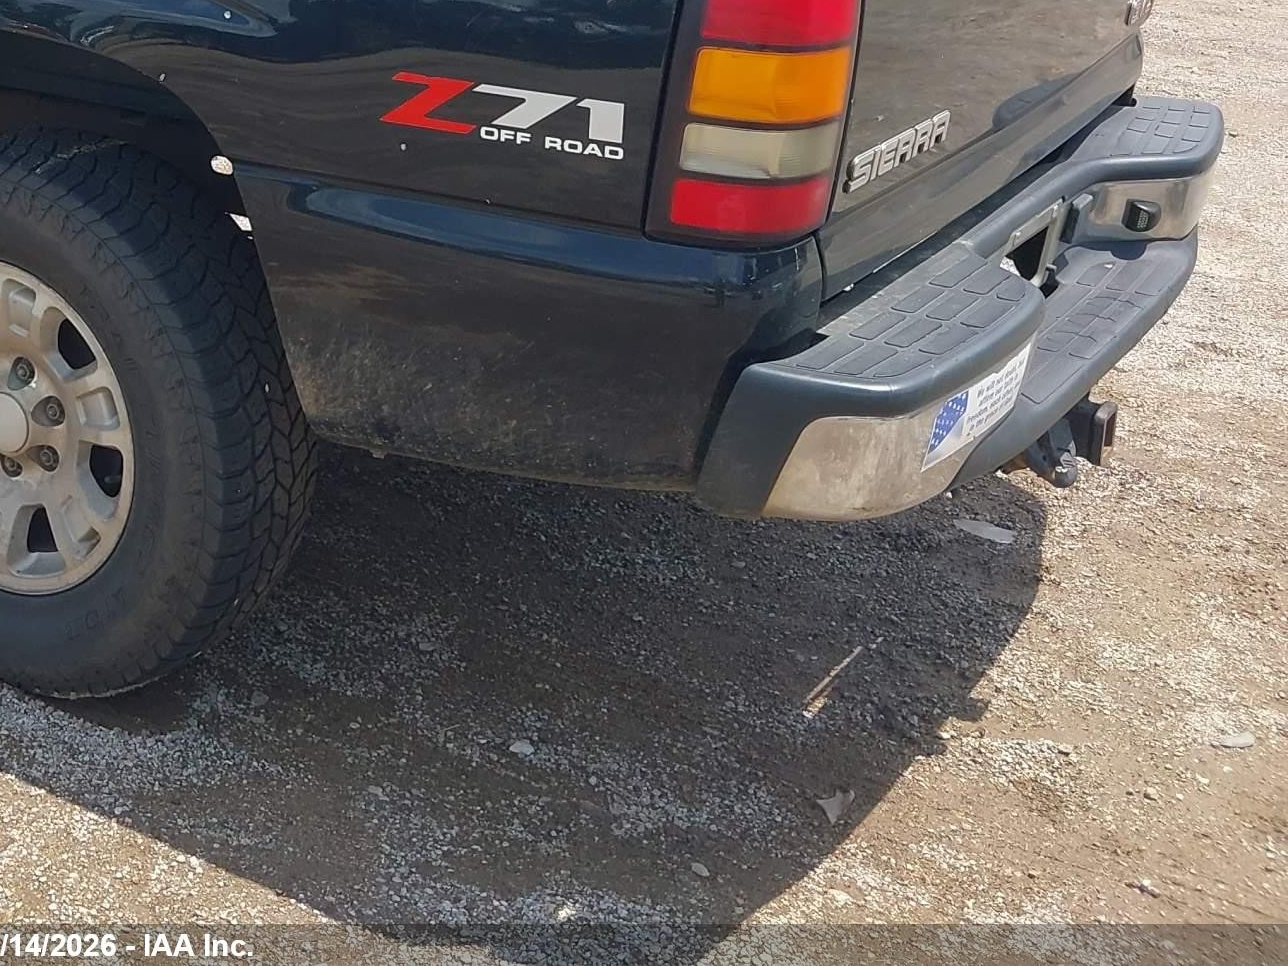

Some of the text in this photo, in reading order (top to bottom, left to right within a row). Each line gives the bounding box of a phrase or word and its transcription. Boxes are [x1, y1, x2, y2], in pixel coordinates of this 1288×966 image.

[379, 69, 626, 144] Z71
[479, 125, 625, 161] OFF ROAD
[843, 109, 951, 194] SIERRA
